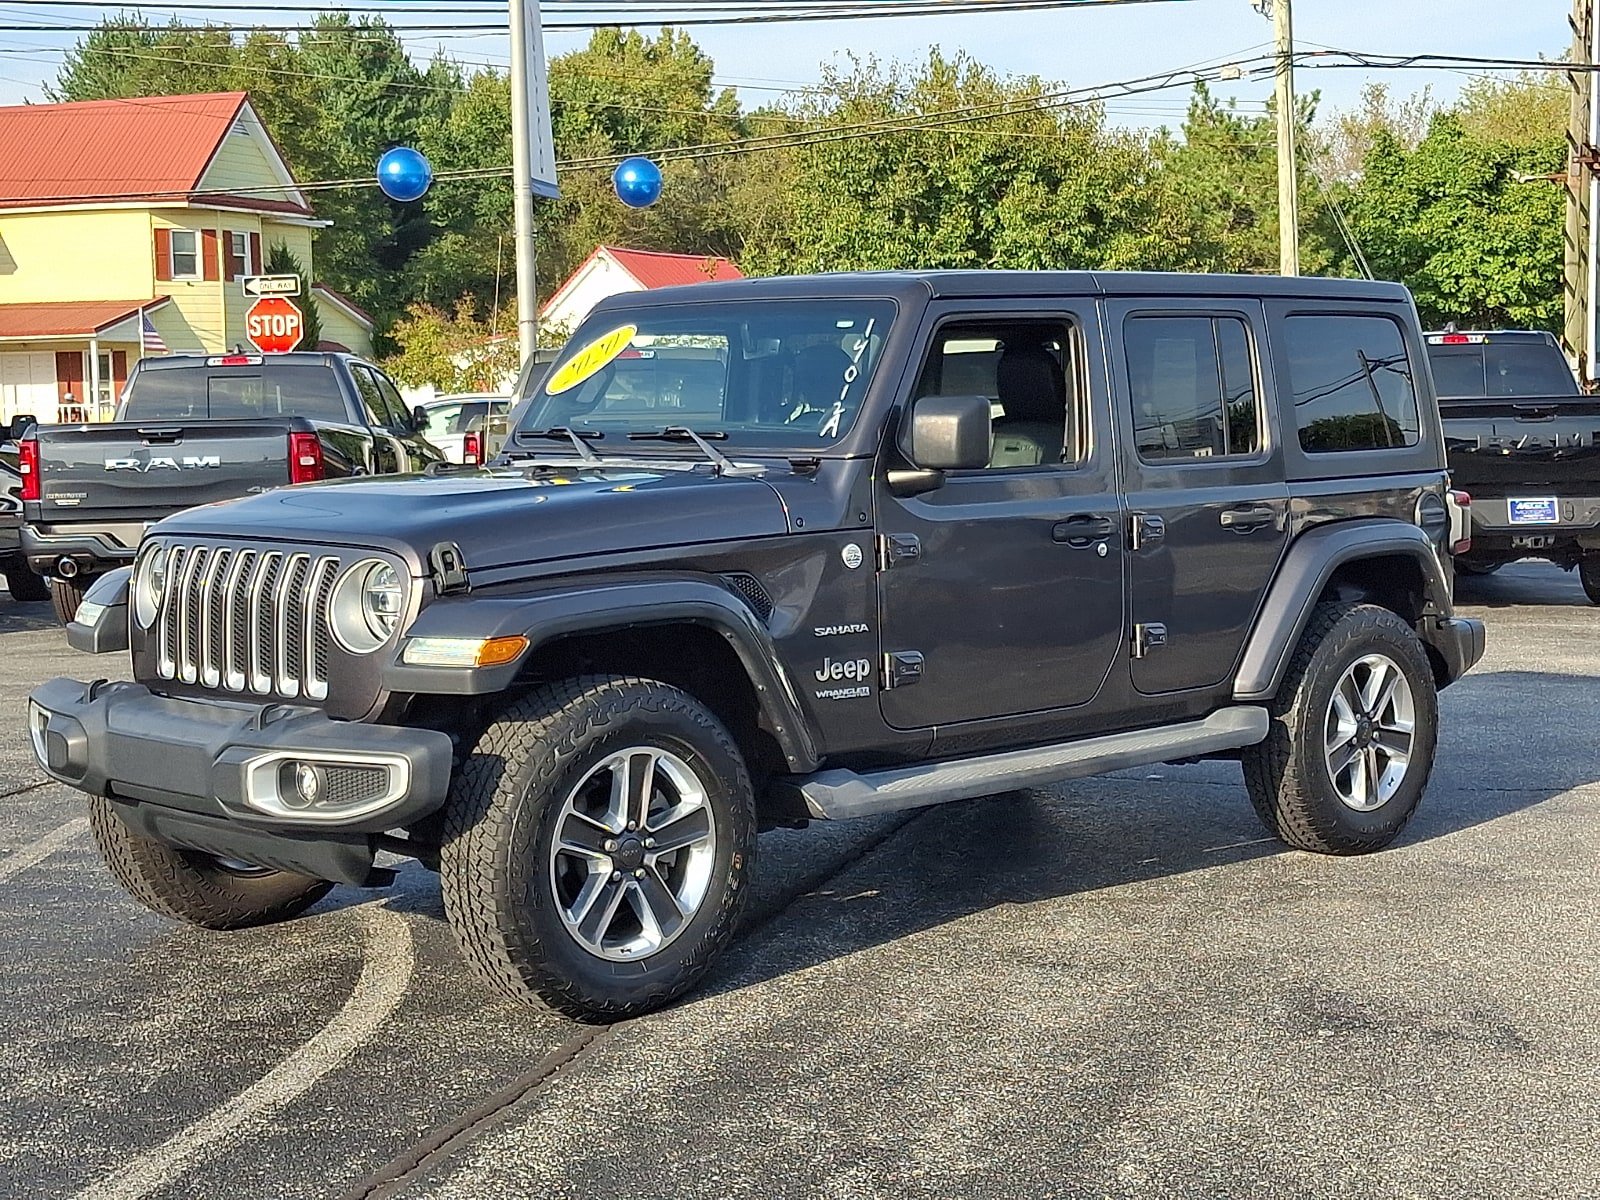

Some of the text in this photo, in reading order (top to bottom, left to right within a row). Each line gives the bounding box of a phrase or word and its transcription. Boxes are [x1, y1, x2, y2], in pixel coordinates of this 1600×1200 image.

[260, 282, 275, 290] ONE
[250, 314, 299, 336] STOP
[559, 332, 621, 388] 2020
[1477, 432, 1585, 451] RAM
[104, 455, 220, 473] RAM
[814, 623, 870, 637] SAHARA
[815, 657, 871, 682] Jeep
[815, 686, 871, 698] WRANGLER
